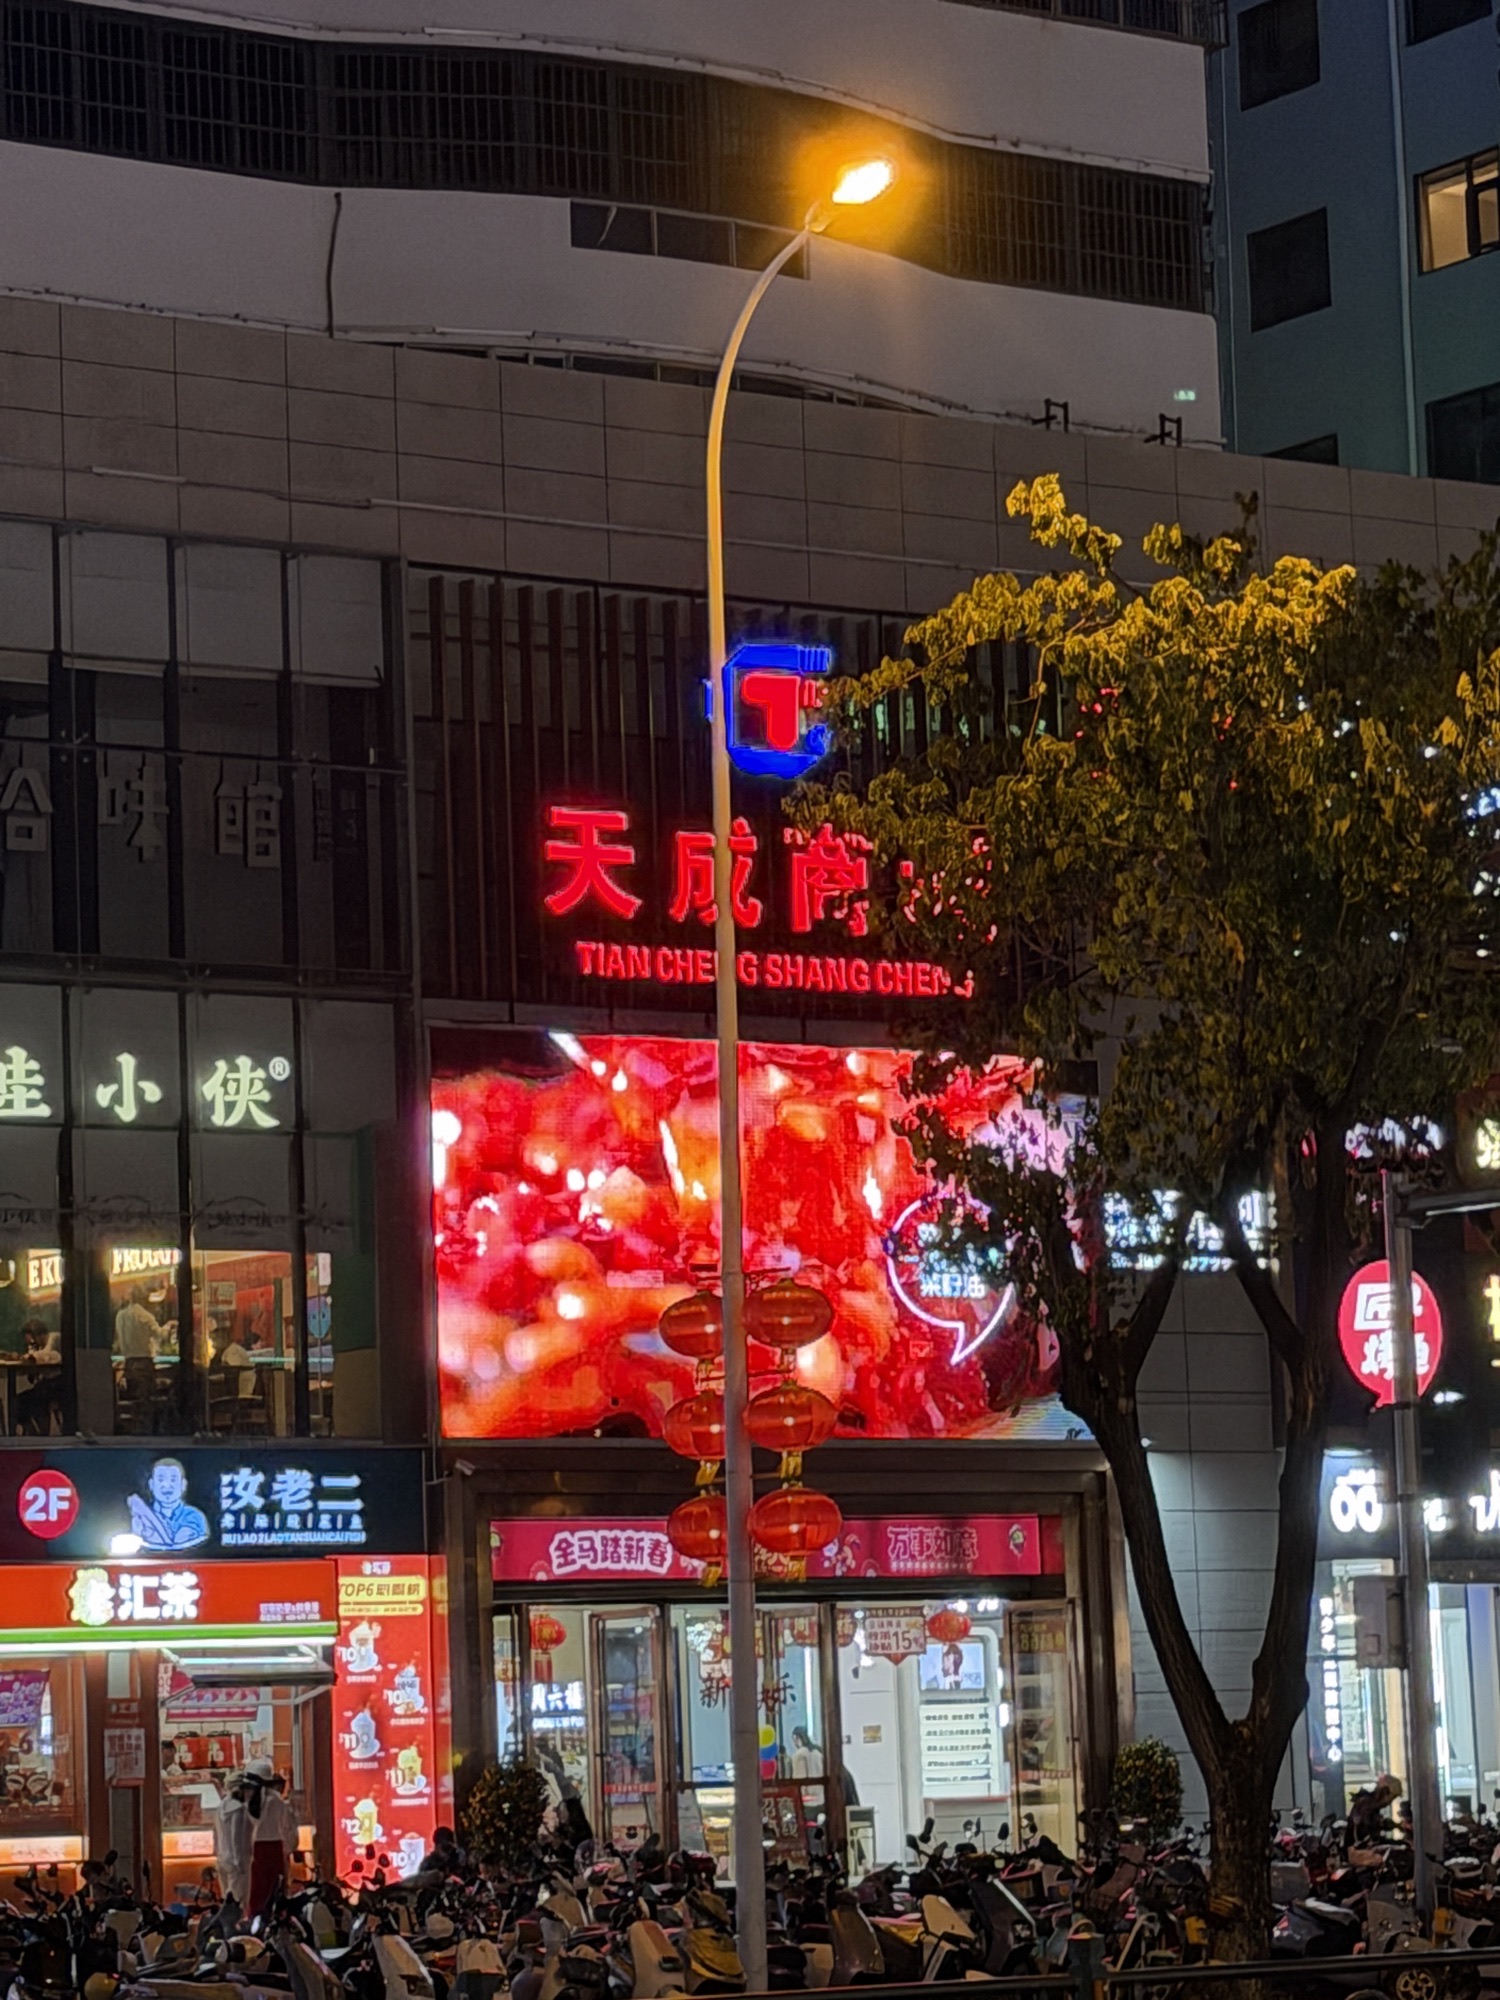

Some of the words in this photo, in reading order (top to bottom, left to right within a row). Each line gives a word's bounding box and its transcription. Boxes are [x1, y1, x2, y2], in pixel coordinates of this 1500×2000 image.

[576, 940, 651, 980] TIAN
[656, 946, 758, 987] CHEG
[765, 953, 870, 993] SHANG
[24, 1487, 71, 1522] 2F
[220, 1467, 365, 1511] 汝老二
[551, 1532, 670, 1573] 金马踏新春
[887, 1525, 978, 1560] 万事如意
